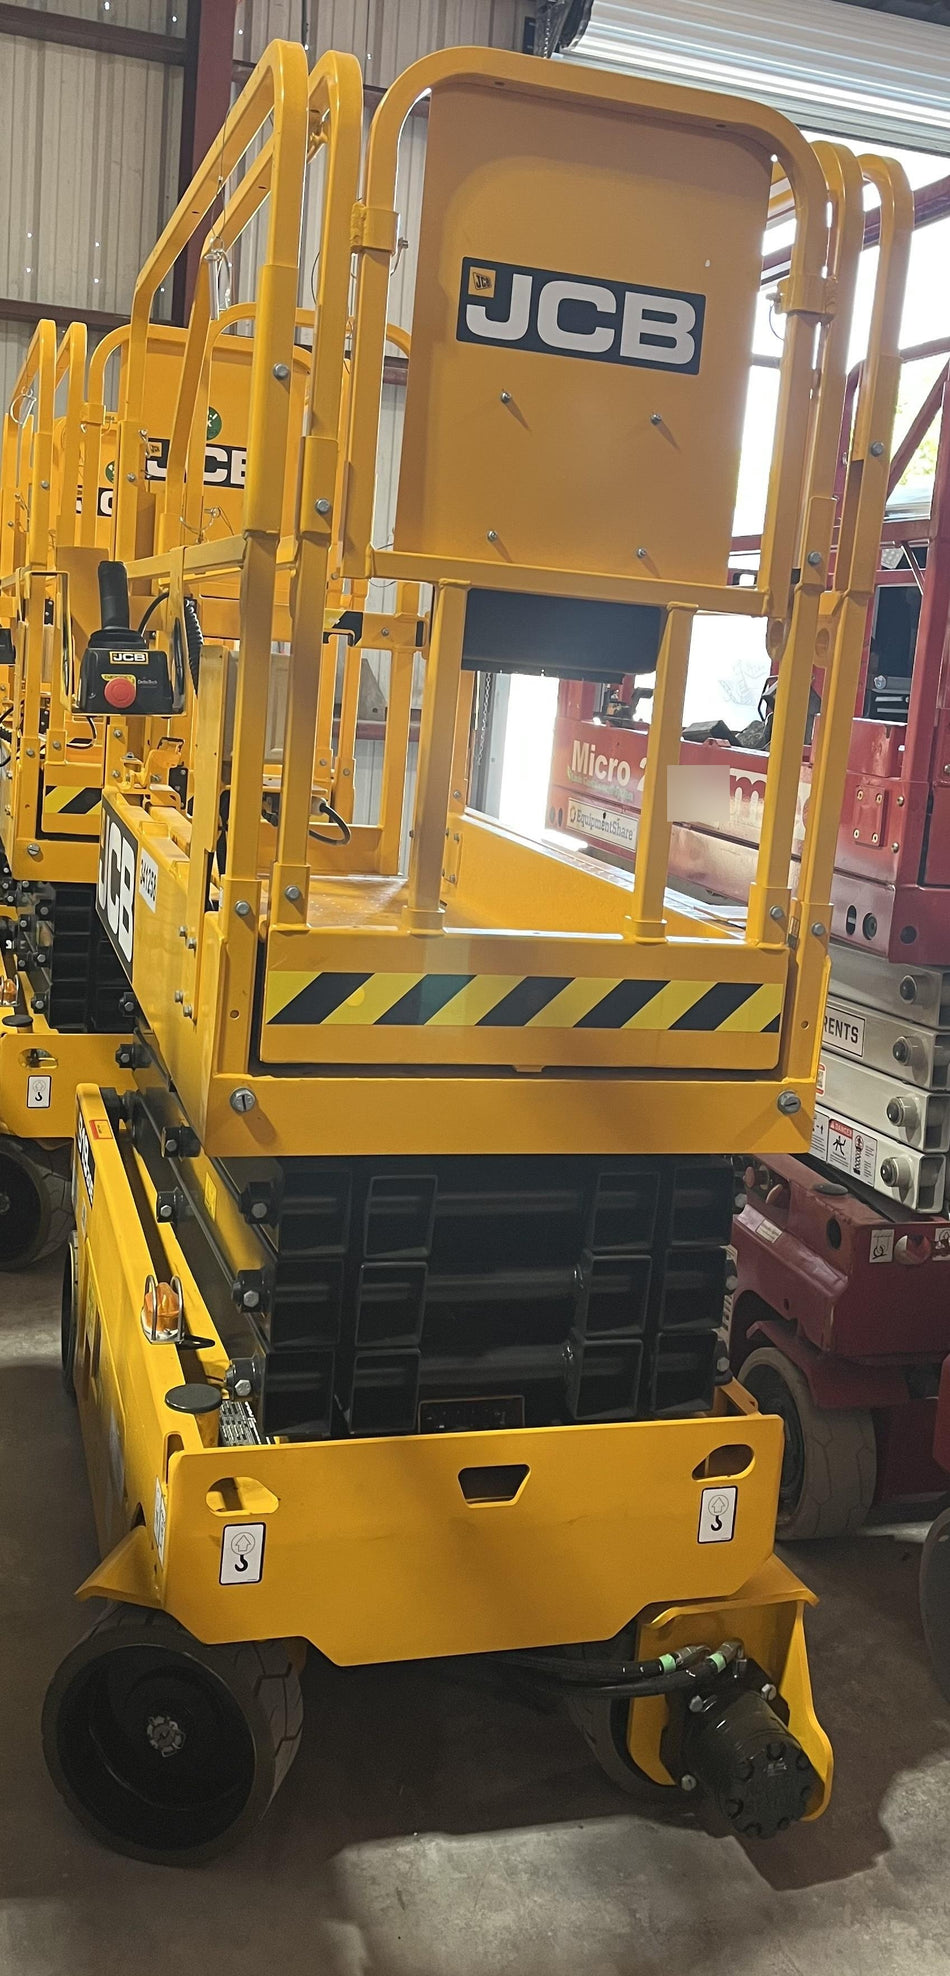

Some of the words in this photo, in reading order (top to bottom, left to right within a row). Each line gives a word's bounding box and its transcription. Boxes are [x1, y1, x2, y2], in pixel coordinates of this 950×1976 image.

[465, 273, 697, 365] JCB
[113, 652, 146, 662] JCB
[571, 739, 631, 787] Micro
[576, 809, 633, 841] EquipmentShare
[99, 812, 135, 963] JCB
[824, 1017, 859, 1044] RENTS
